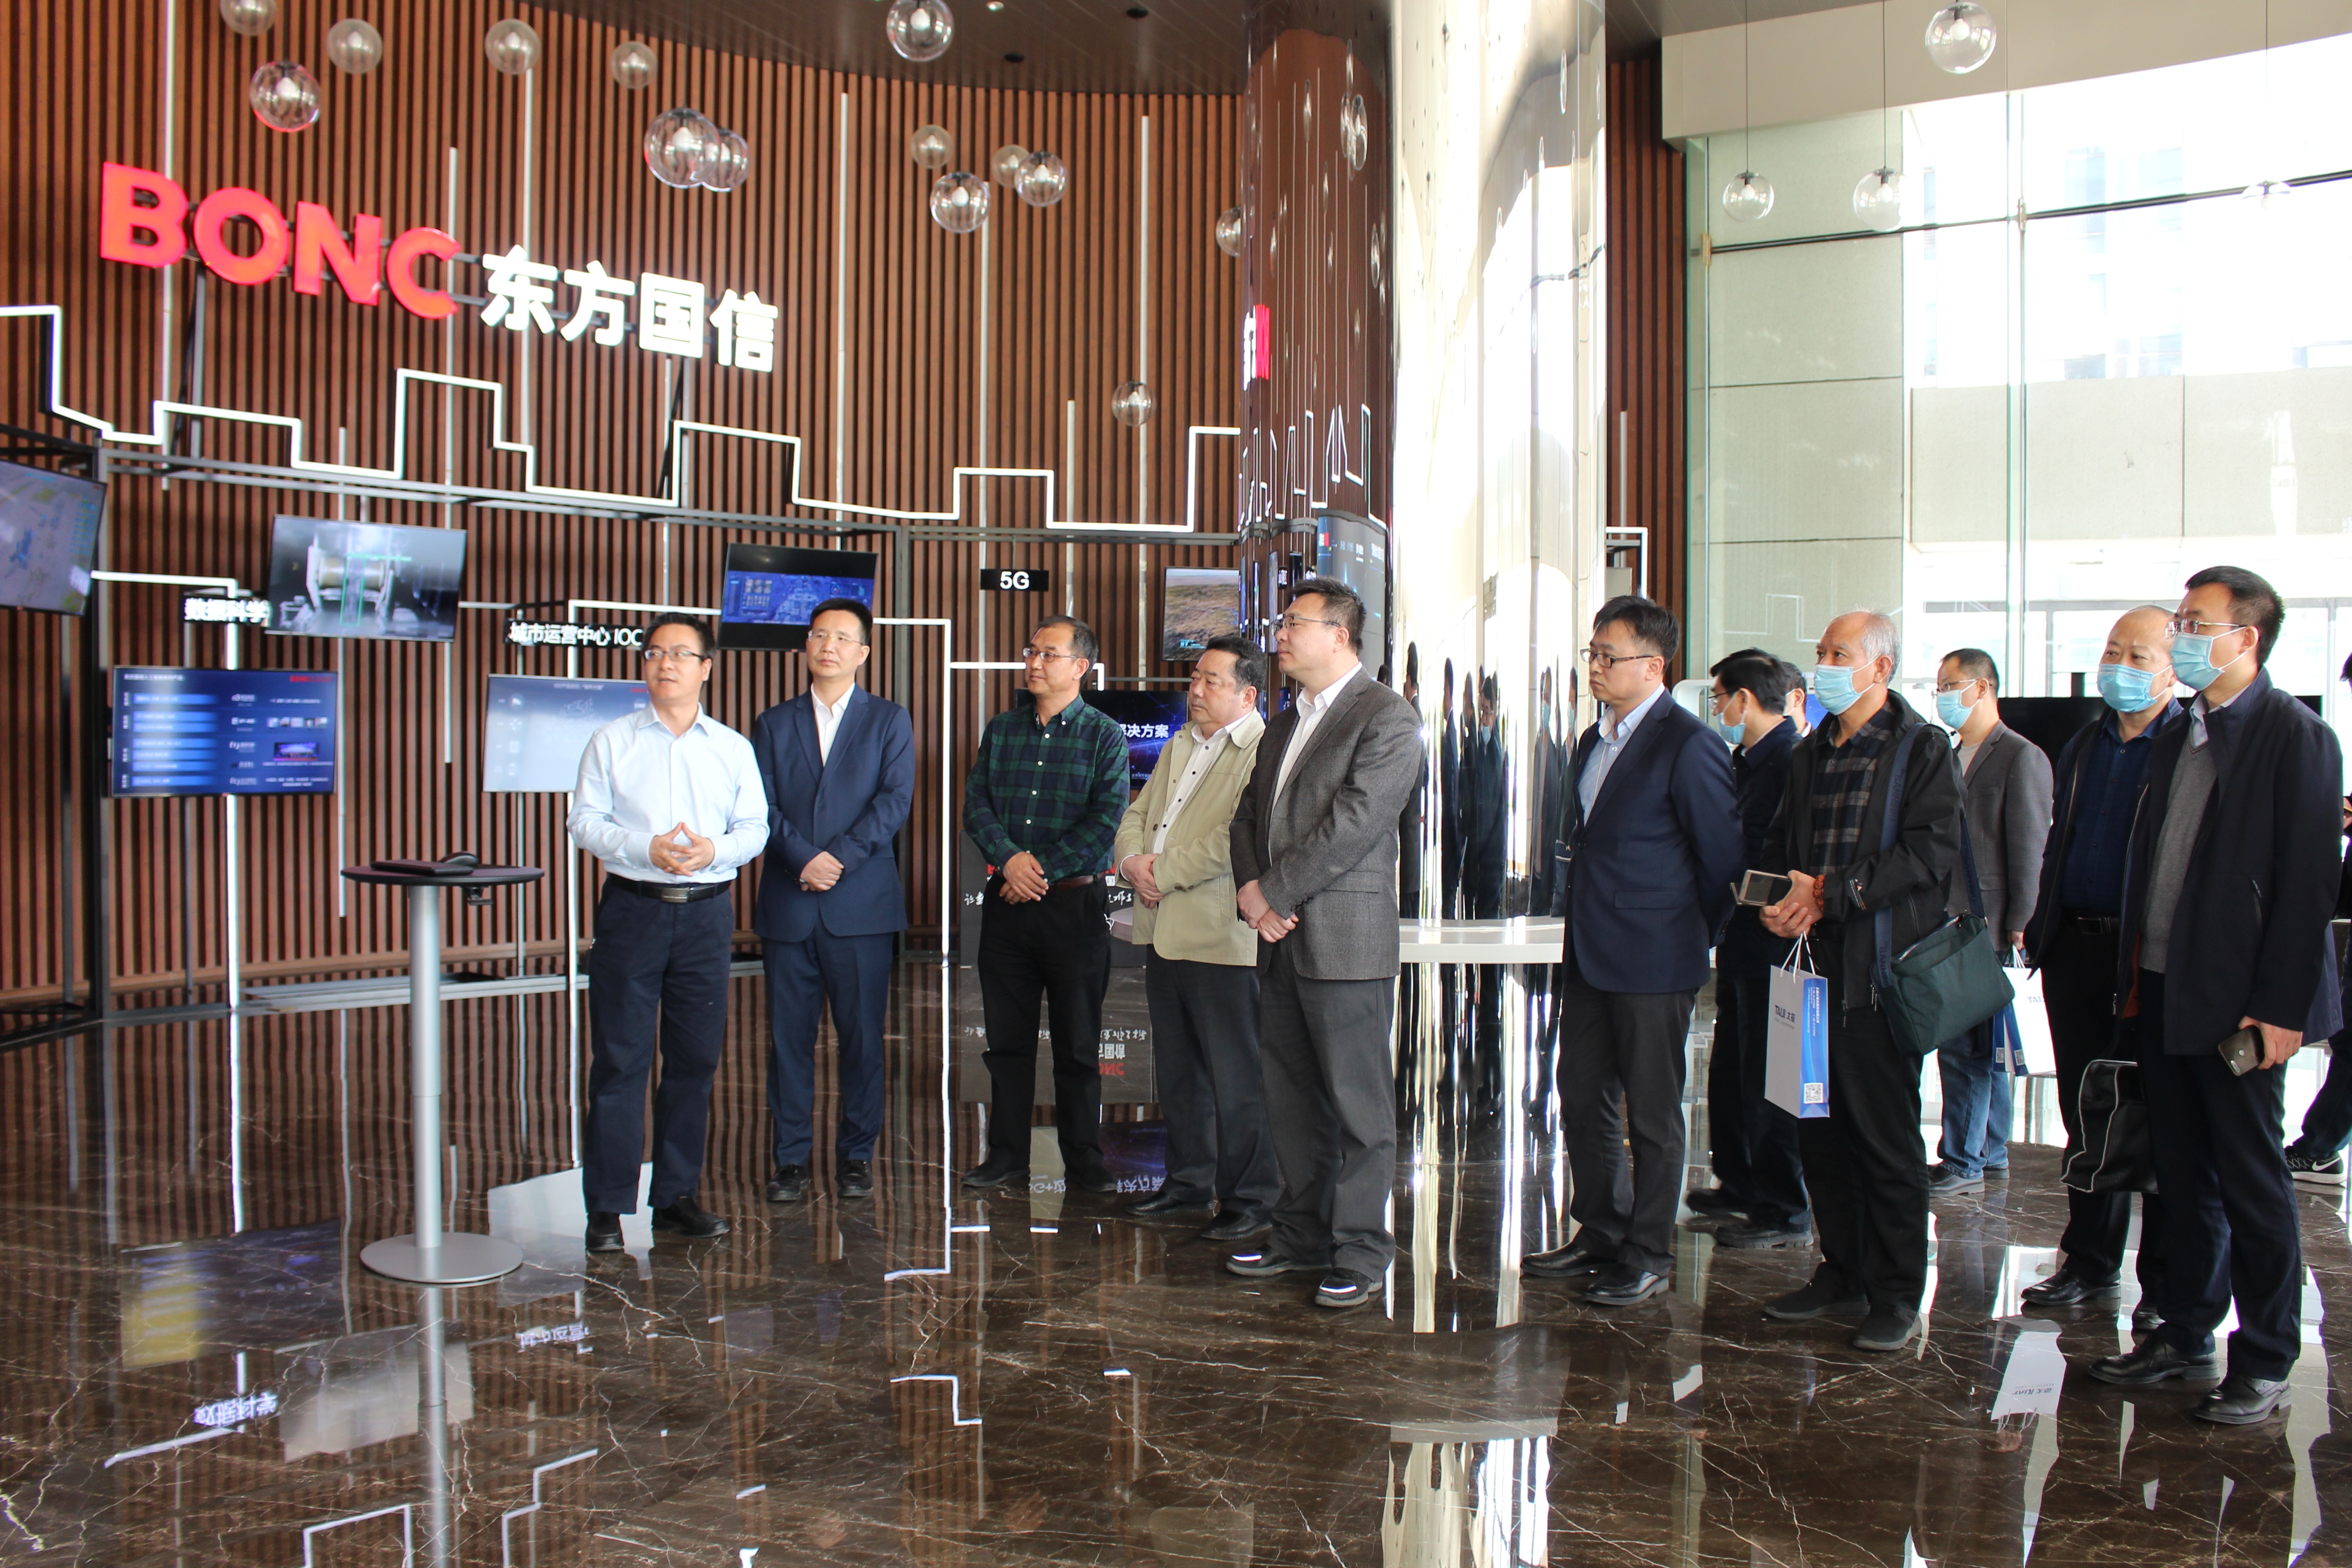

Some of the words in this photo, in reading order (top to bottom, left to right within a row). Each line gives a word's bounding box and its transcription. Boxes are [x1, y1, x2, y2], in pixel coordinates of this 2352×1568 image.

[100, 161, 461, 320] BONC
[480, 243, 779, 373] 东方国信
[999, 571, 1030, 590] 5G
[507, 621, 611, 646] 城市运营中心
[613, 627, 644, 646] IOC
[1774, 1005, 1786, 1019] TAIJI
